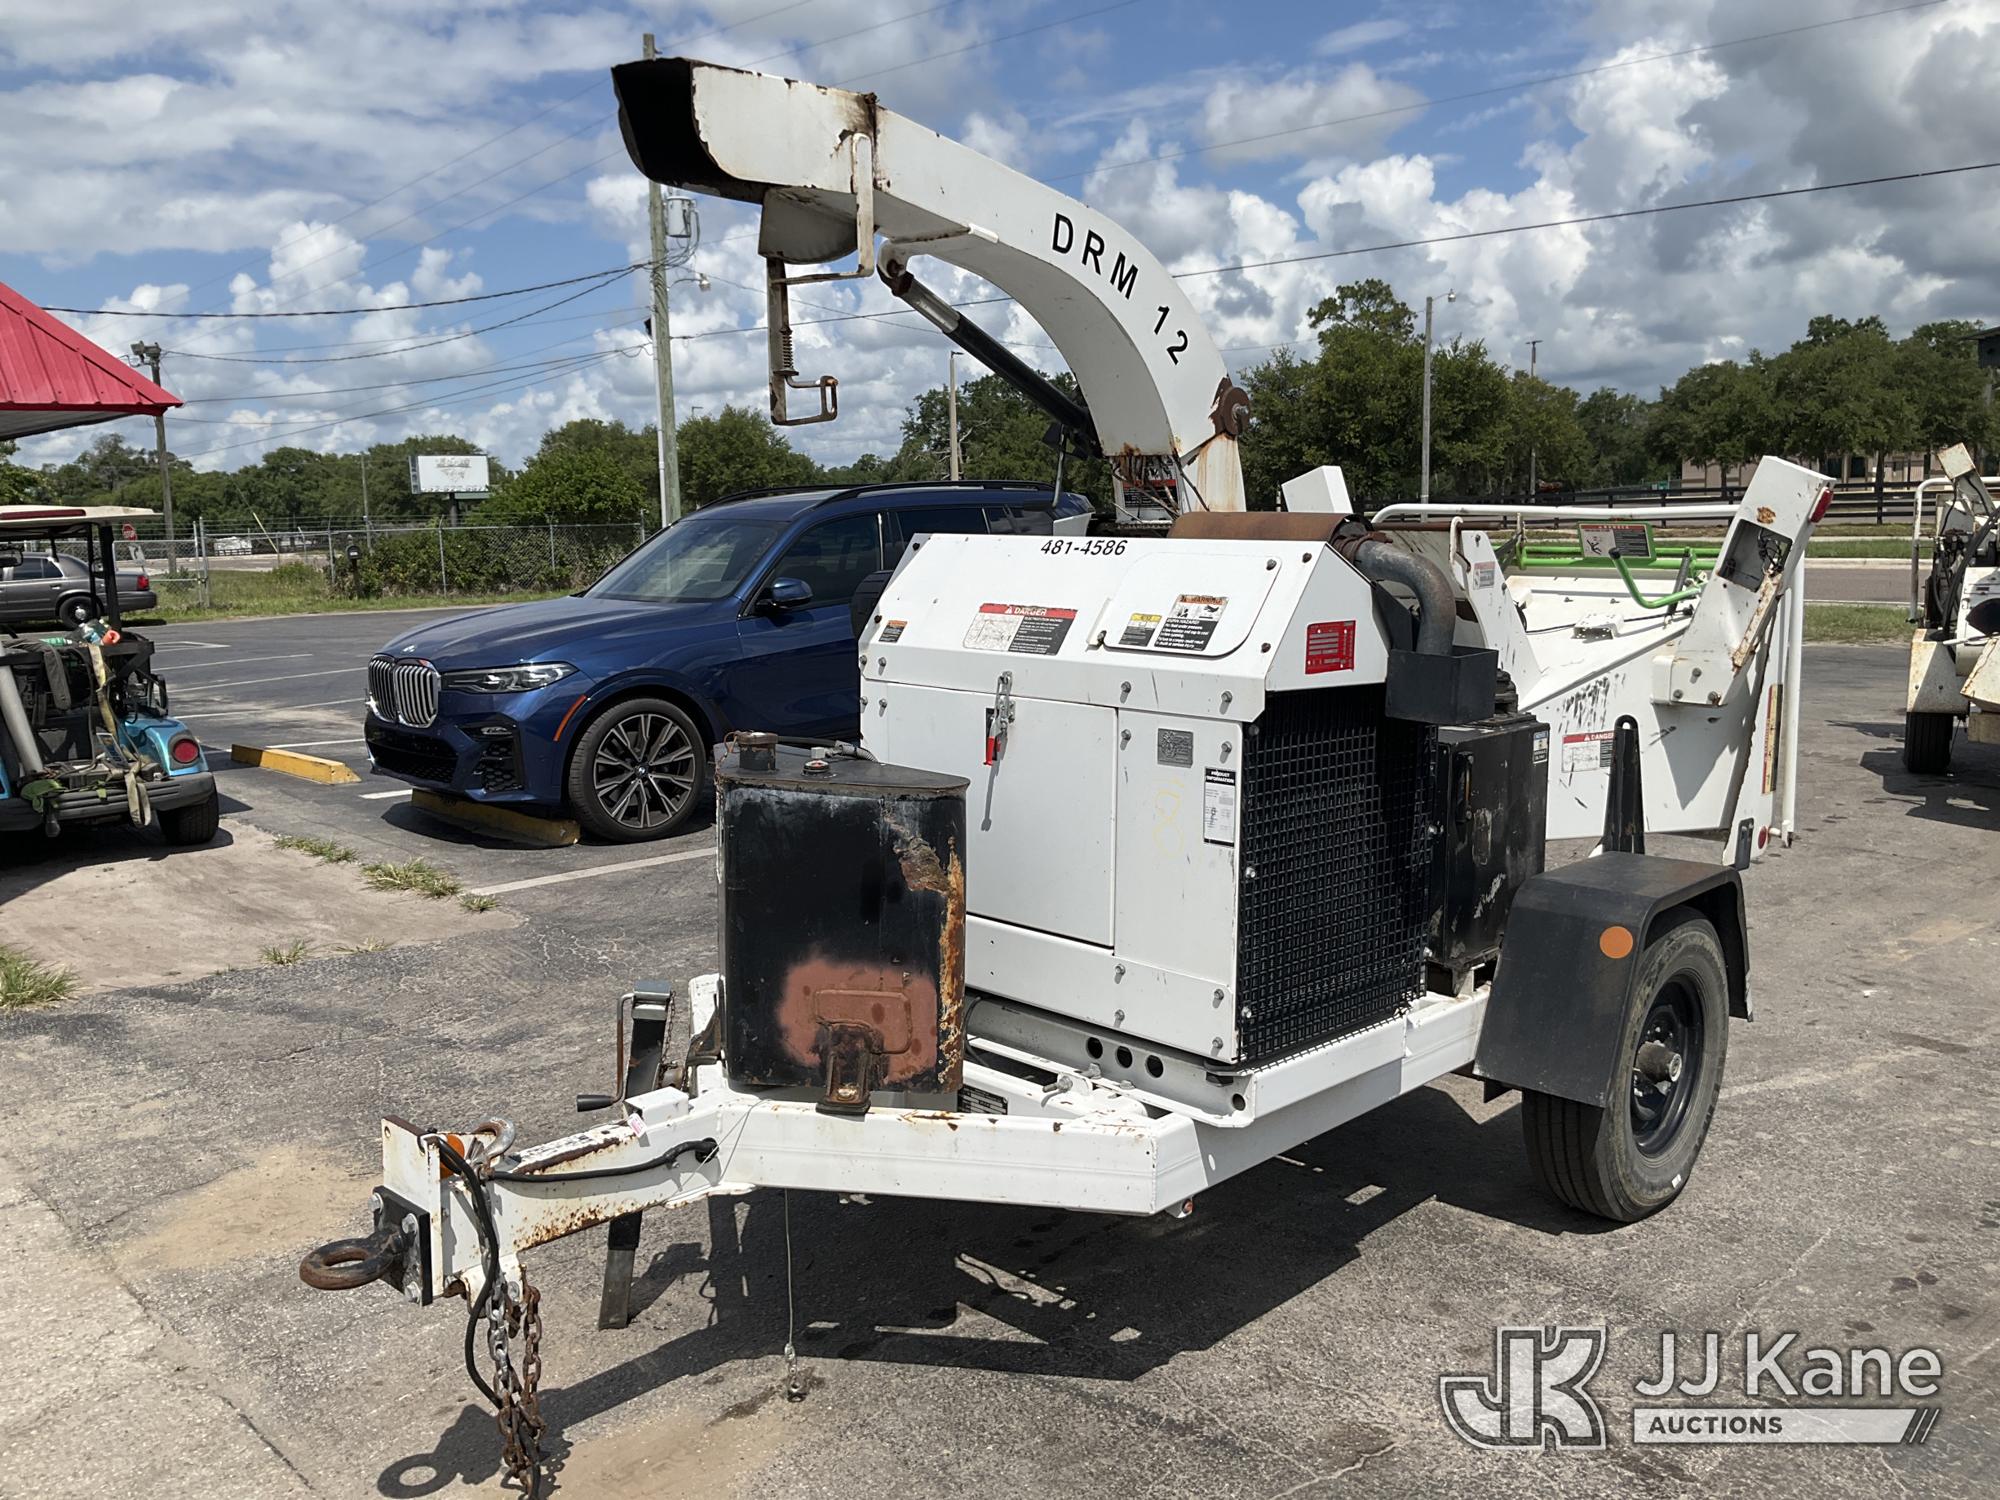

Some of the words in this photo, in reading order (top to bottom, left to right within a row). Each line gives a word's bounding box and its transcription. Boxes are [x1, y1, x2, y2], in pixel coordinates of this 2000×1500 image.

[1052, 212, 1139, 300] DRM
[1153, 305, 1188, 366] 12
[1040, 539, 1128, 556] 481-4586
[1014, 607, 1048, 616] DANGER
